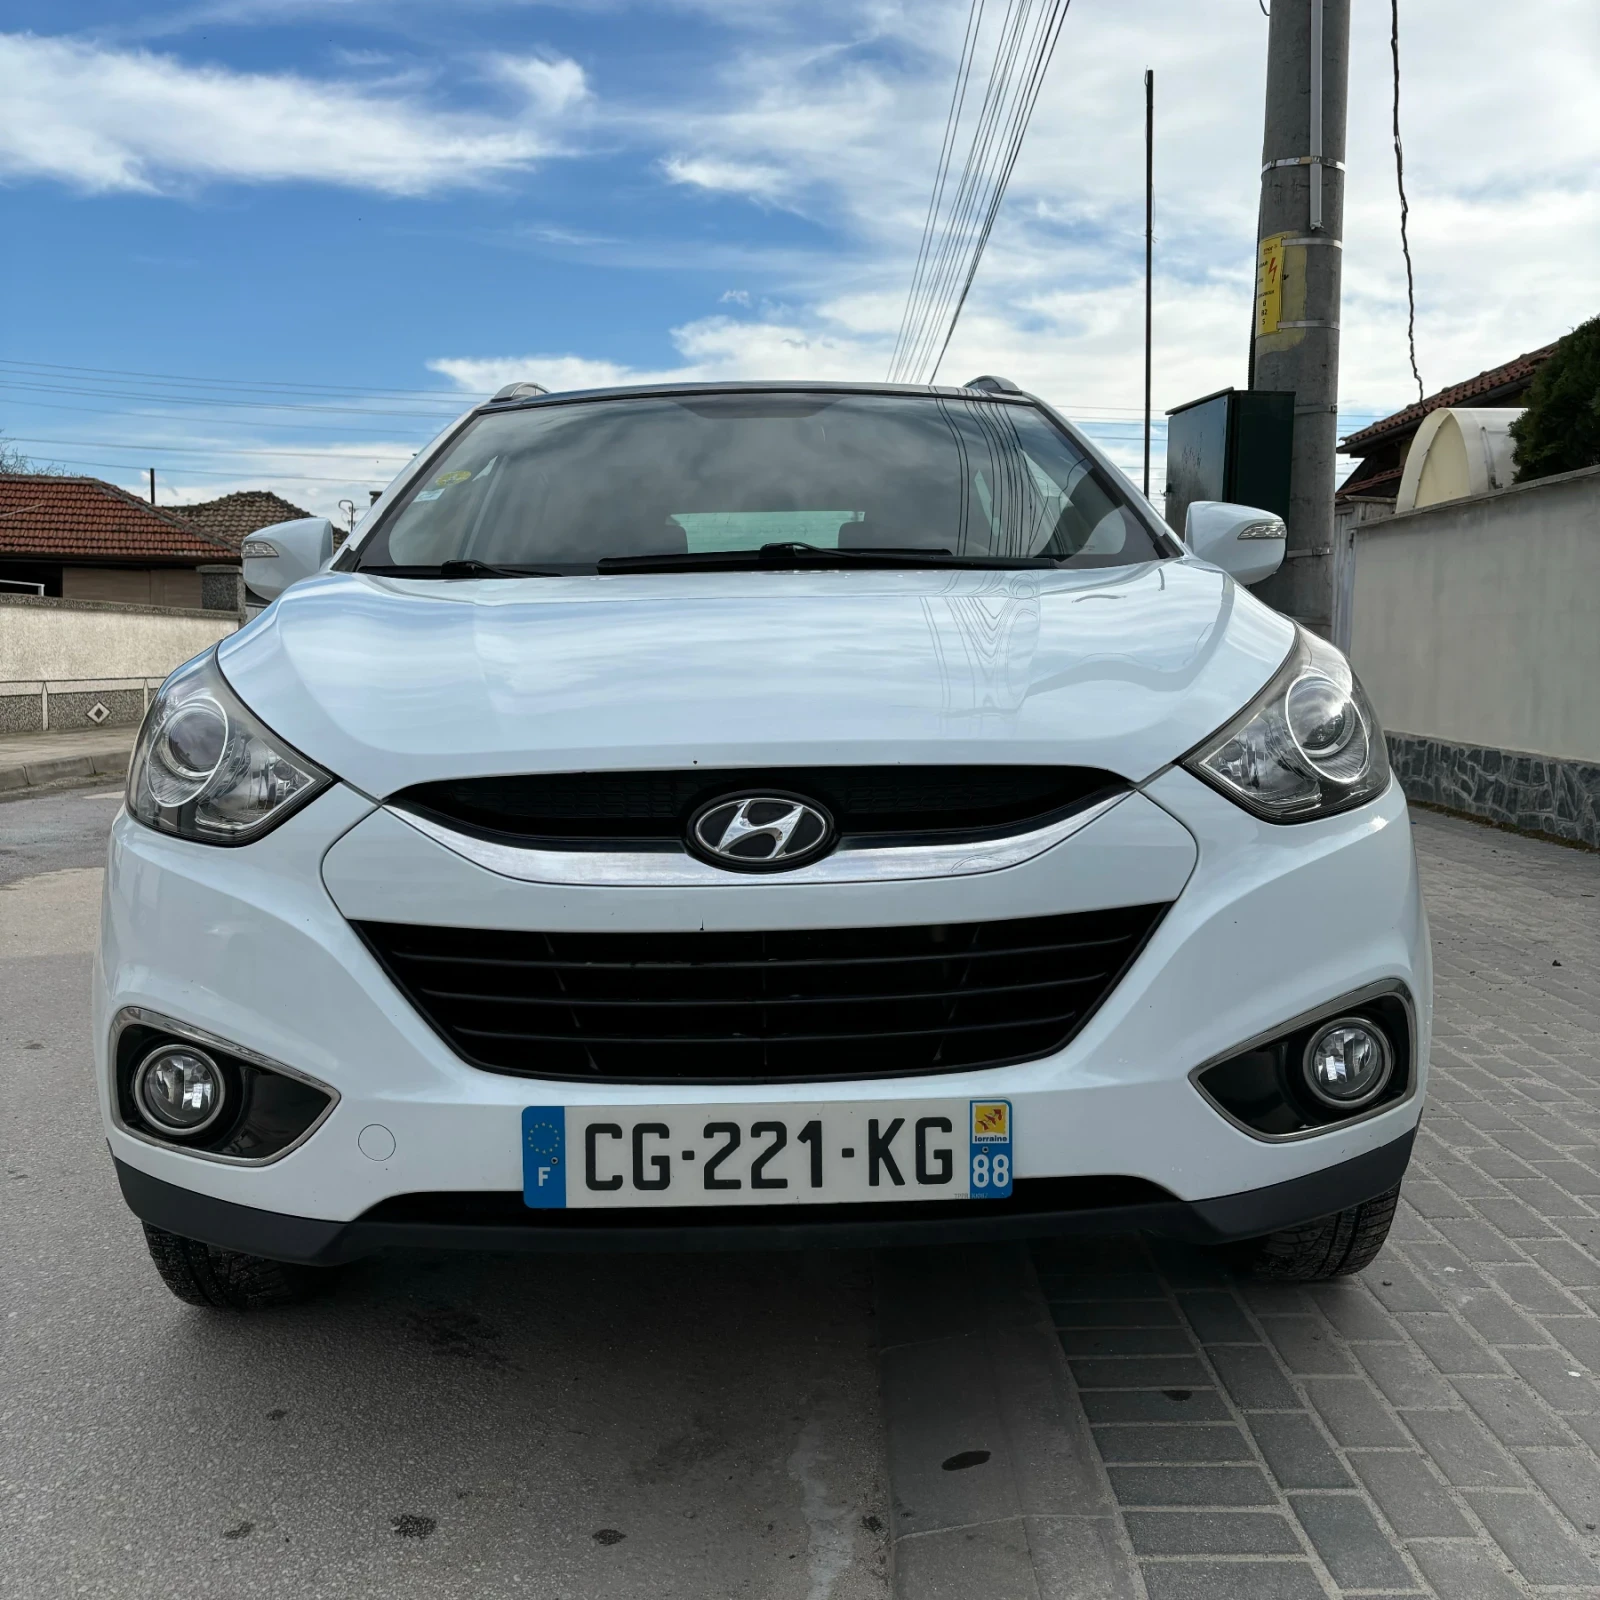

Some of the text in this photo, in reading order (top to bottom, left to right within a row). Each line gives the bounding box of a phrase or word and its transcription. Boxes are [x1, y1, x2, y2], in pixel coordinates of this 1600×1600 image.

[974, 1135, 1008, 1143] lorraine
[585, 1117, 953, 1191] CG-221-KG
[538, 1167, 551, 1187] F
[972, 1154, 1010, 1188] 88
